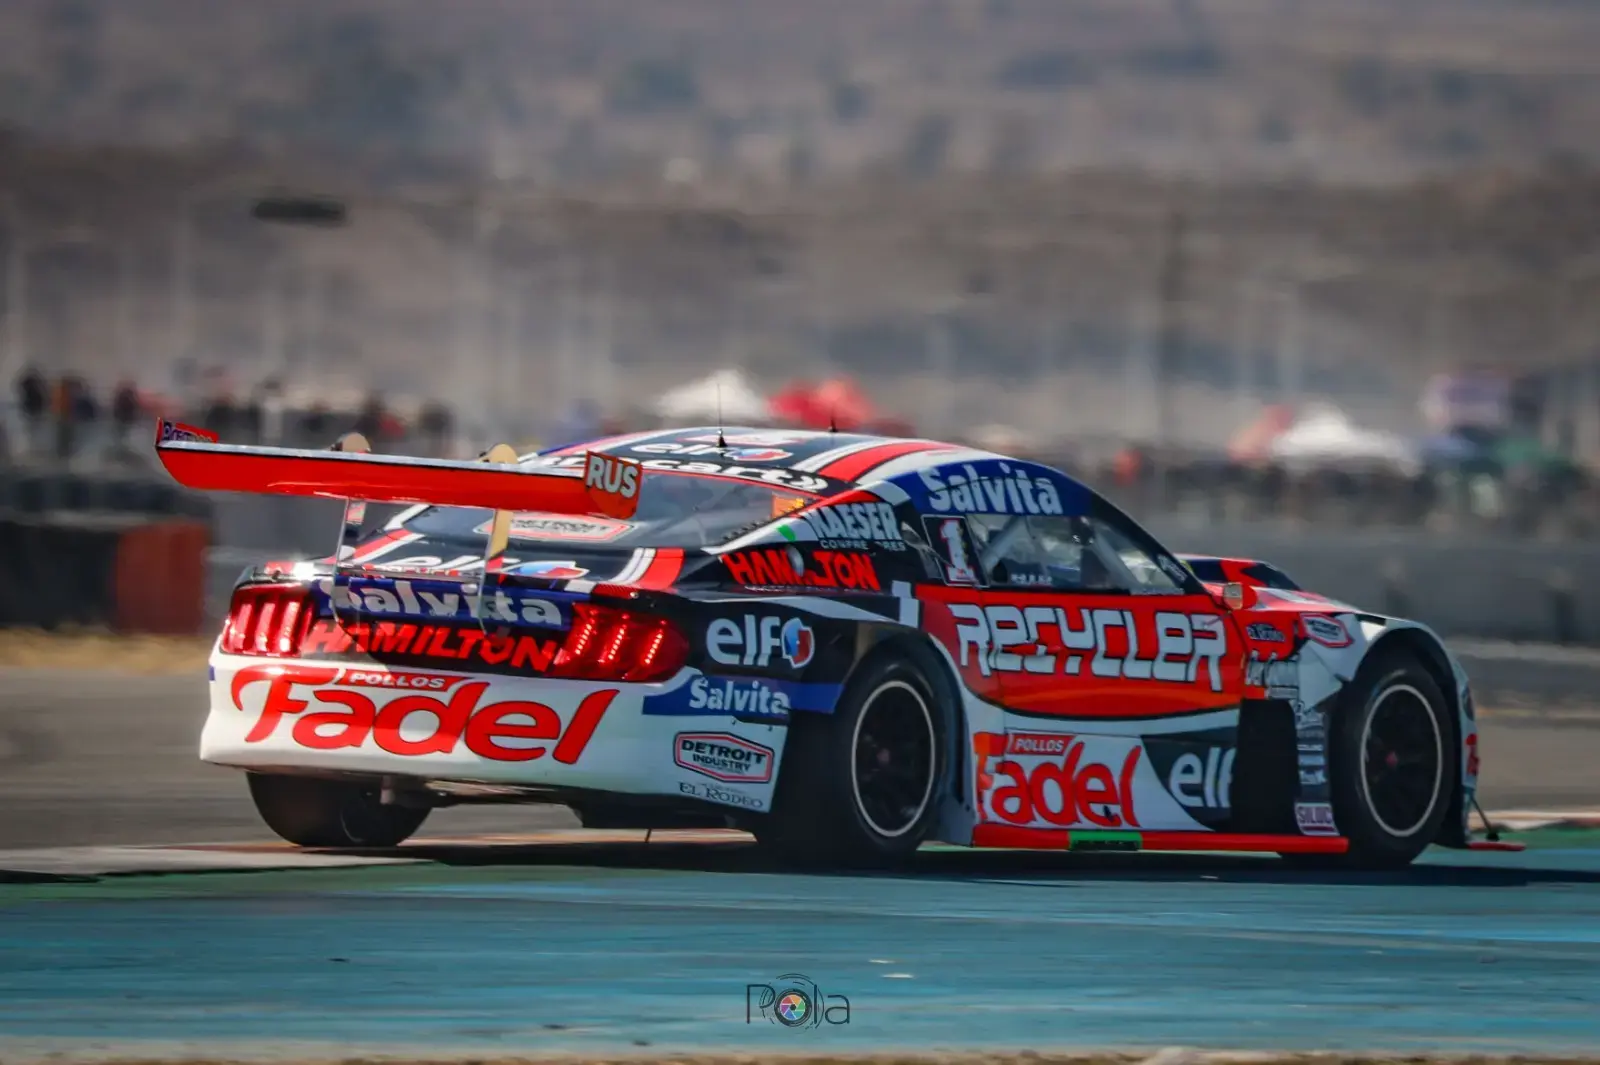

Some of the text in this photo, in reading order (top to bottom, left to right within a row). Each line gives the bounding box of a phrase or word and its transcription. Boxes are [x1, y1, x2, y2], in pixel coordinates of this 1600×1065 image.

[586, 456, 638, 498] RUS
[916, 462, 1063, 515] Salvita
[939, 518, 978, 584] 1
[316, 578, 563, 627] Salvita
[301, 620, 557, 672] HAMILTON
[706, 614, 782, 667] elf
[349, 672, 446, 690] POLLOS
[689, 676, 790, 715] Salvita
[231, 663, 619, 765] Fadel
[681, 739, 767, 765] DETROIT
[692, 754, 752, 772] INDUSTRY
[1014, 738, 1064, 753] POLLOS
[706, 786, 764, 809] RODEO
